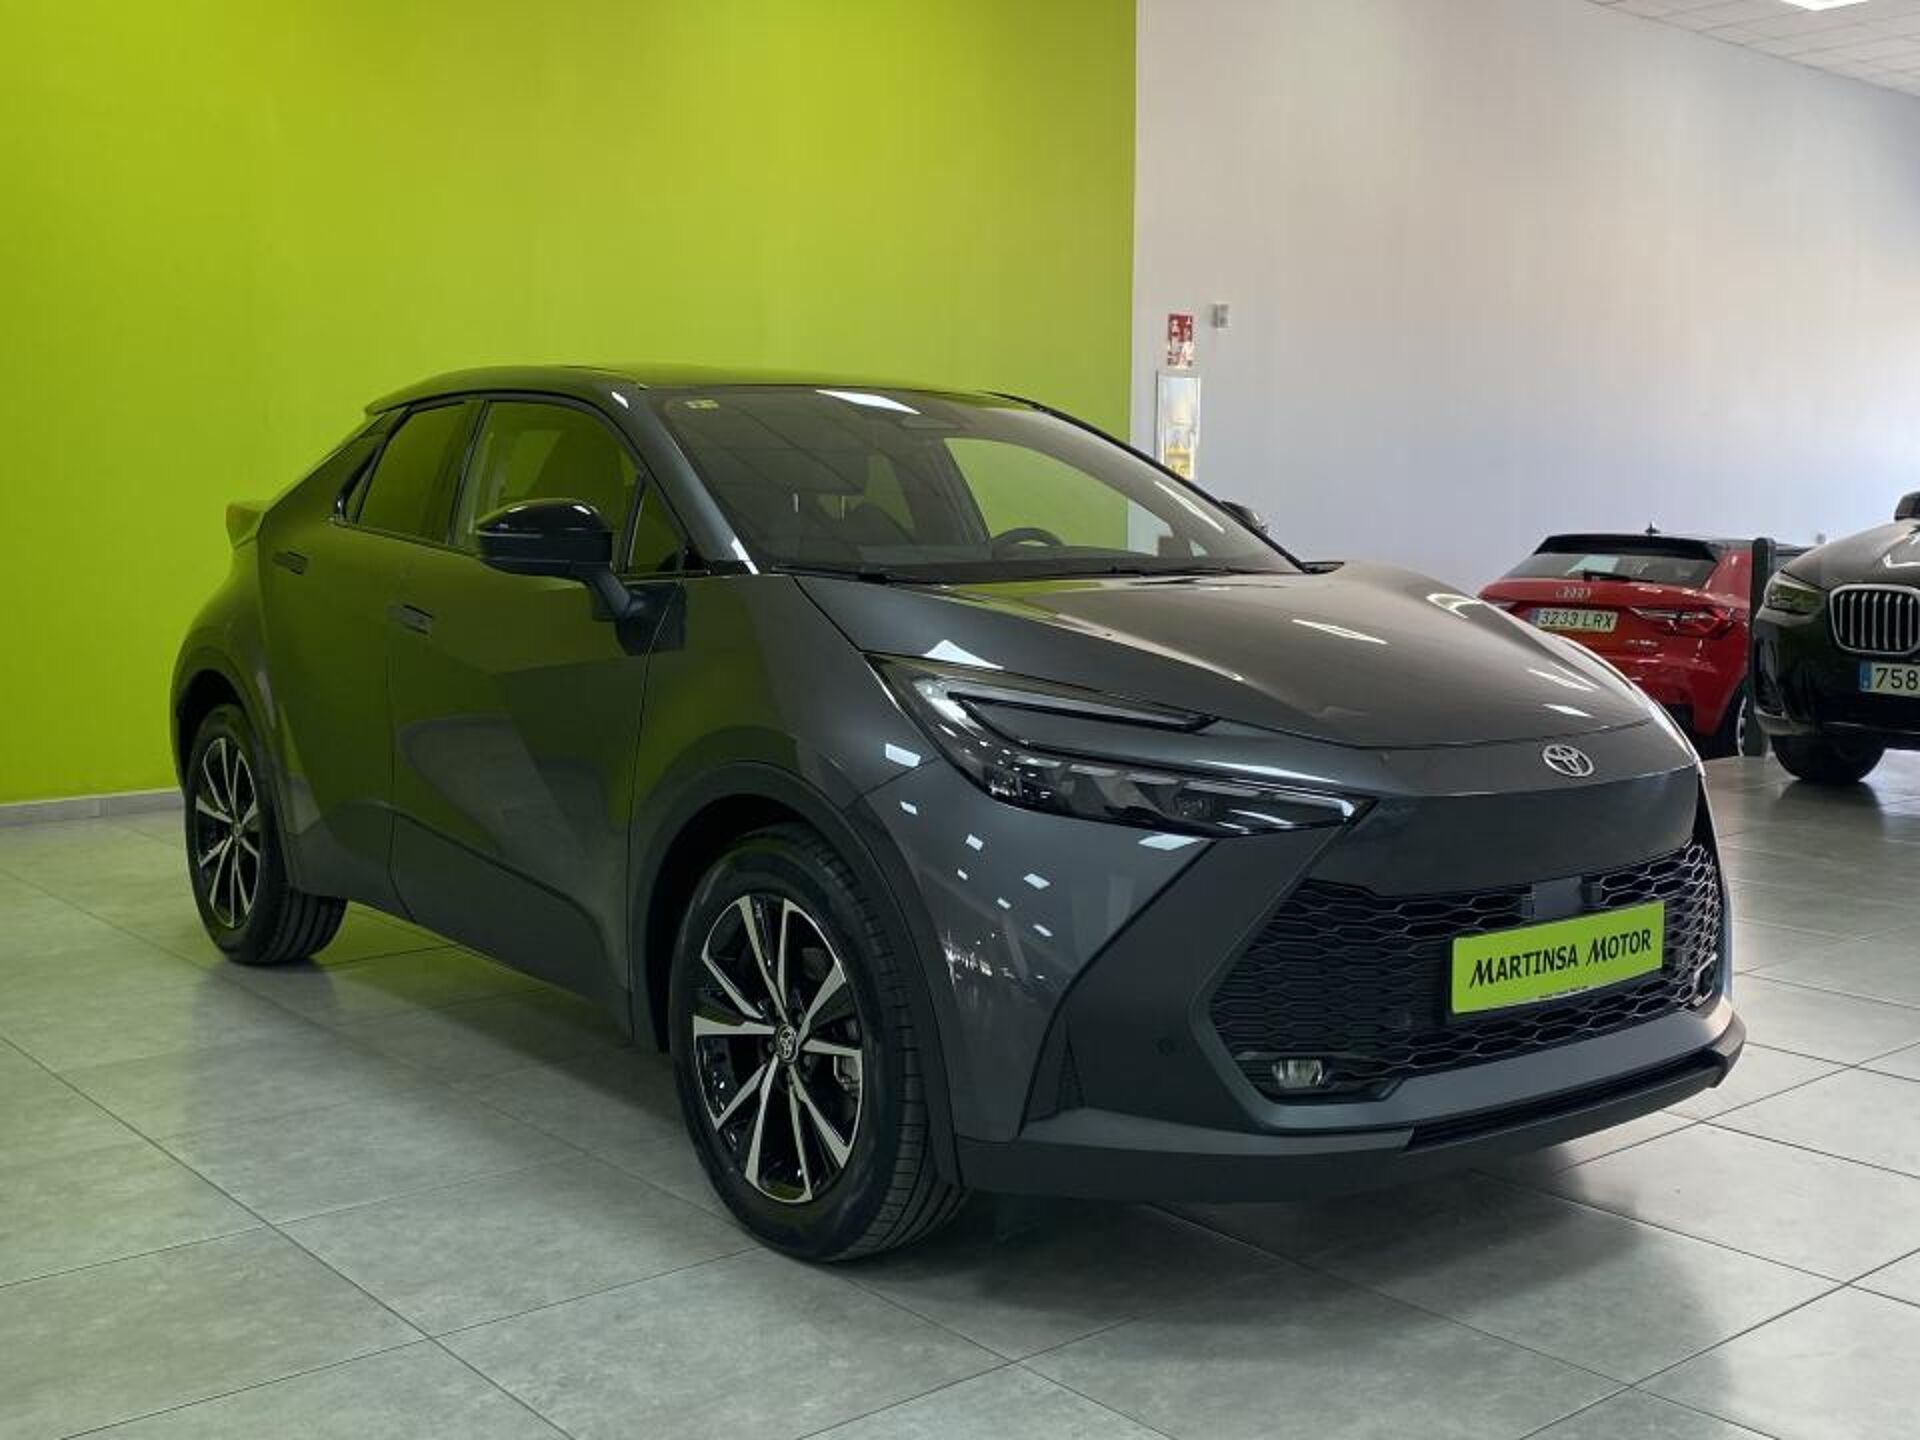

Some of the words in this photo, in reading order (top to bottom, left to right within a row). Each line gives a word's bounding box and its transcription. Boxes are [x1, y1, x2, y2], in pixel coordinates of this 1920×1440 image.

[1581, 613, 1613, 629] LRX
[1470, 944, 1578, 989] MARTINSA
[1586, 928, 1651, 966] MOTOR
